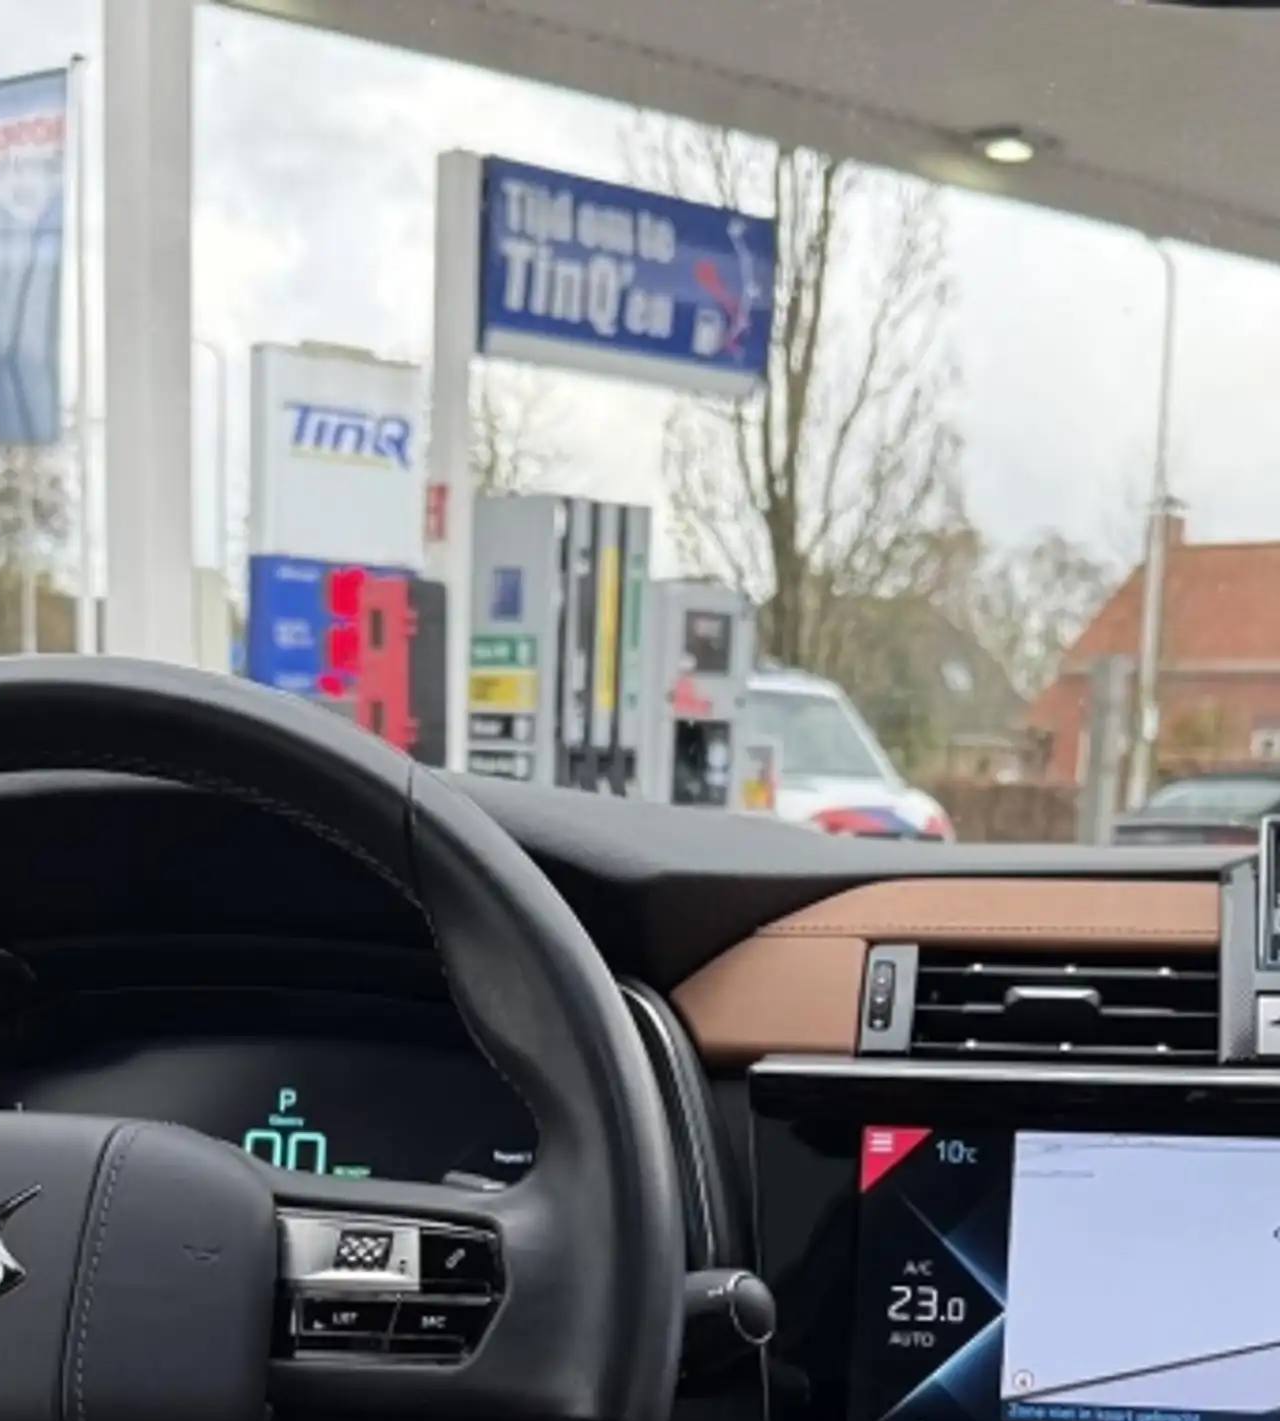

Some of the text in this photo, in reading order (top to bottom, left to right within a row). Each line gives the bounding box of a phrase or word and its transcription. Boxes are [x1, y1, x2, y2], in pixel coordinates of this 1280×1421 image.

[283, 401, 411, 474] TinQ
[279, 1089, 297, 1113] P
[903, 1260, 933, 1276] A/C
[888, 1286, 966, 1322] 23.0
[333, 1311, 358, 1325] LIST
[888, 1331, 935, 1347] AUTO
